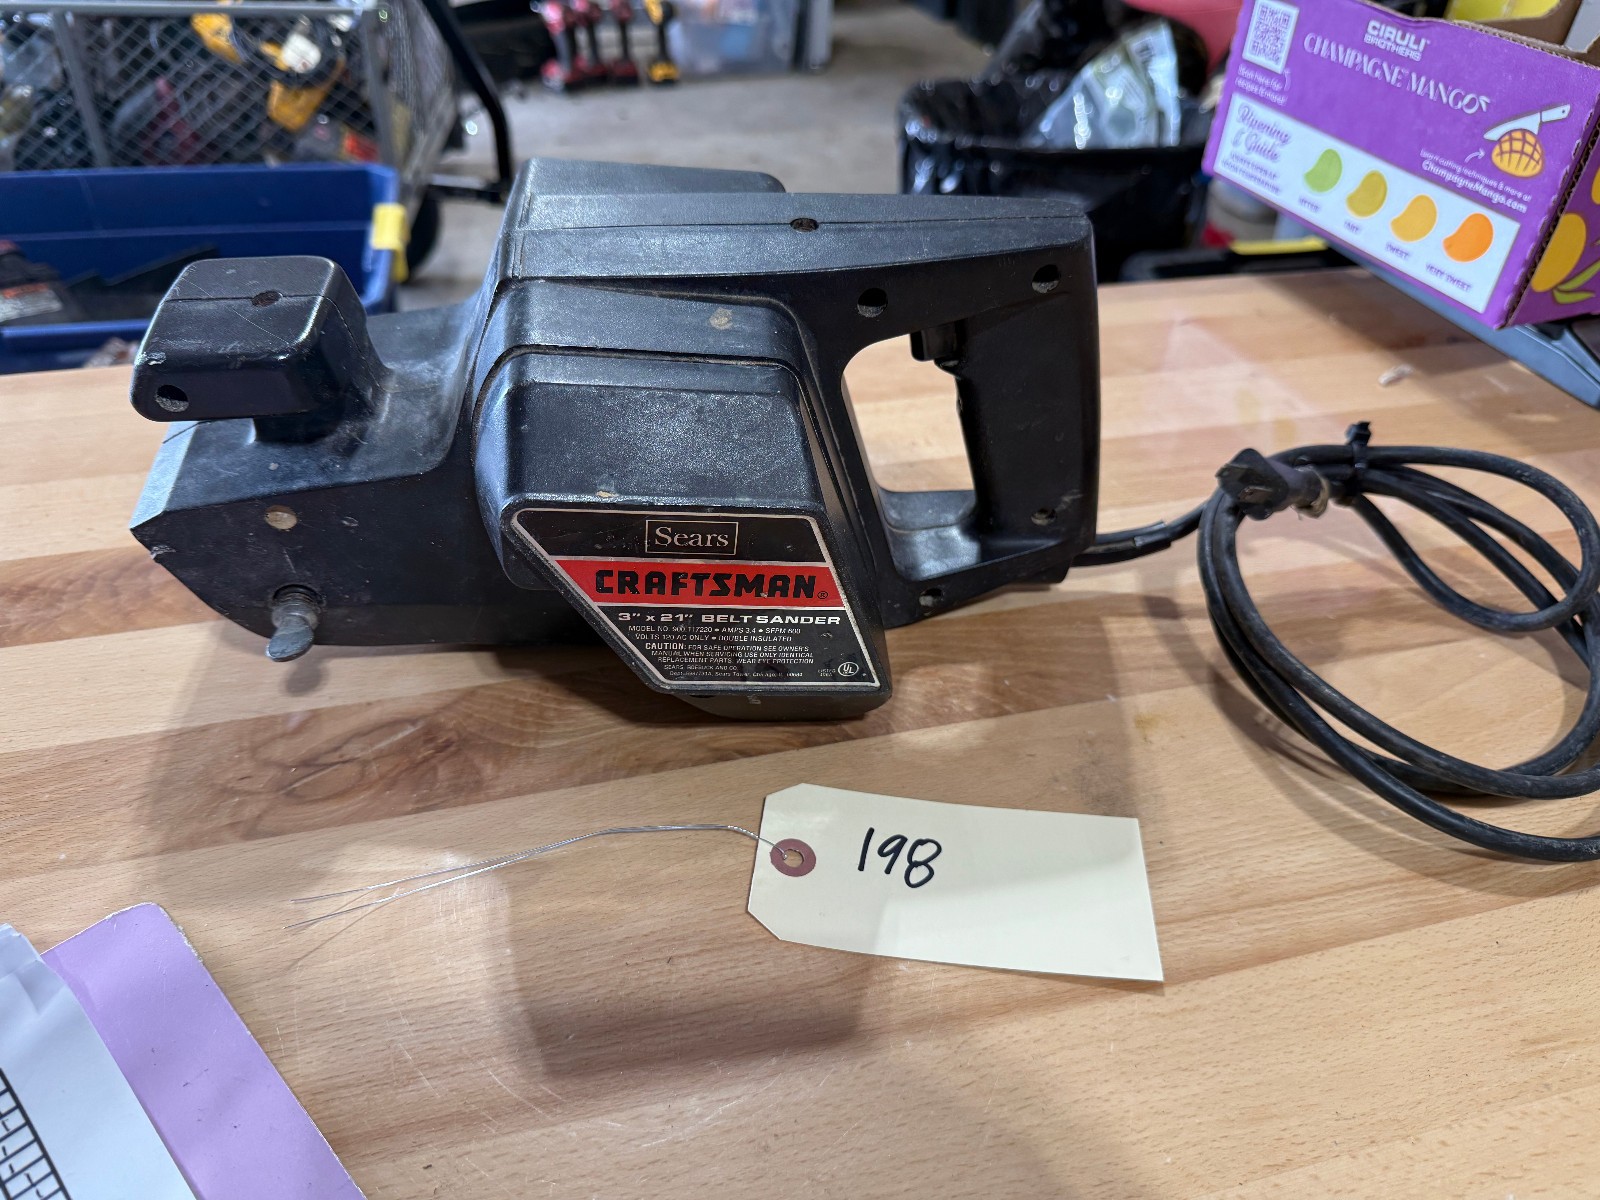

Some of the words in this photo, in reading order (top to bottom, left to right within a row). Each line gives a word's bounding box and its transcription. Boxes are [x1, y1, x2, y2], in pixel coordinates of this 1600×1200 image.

[1303, 32, 1403, 87] CHAMPAGNE
[654, 526, 729, 548] Sears
[618, 612, 641, 621] 3"
[660, 613, 694, 622] 21"
[701, 614, 753, 624] BELT
[755, 615, 841, 625] SANDER
[645, 642, 687, 650] CAUTION:
[857, 827, 942, 889] 198
